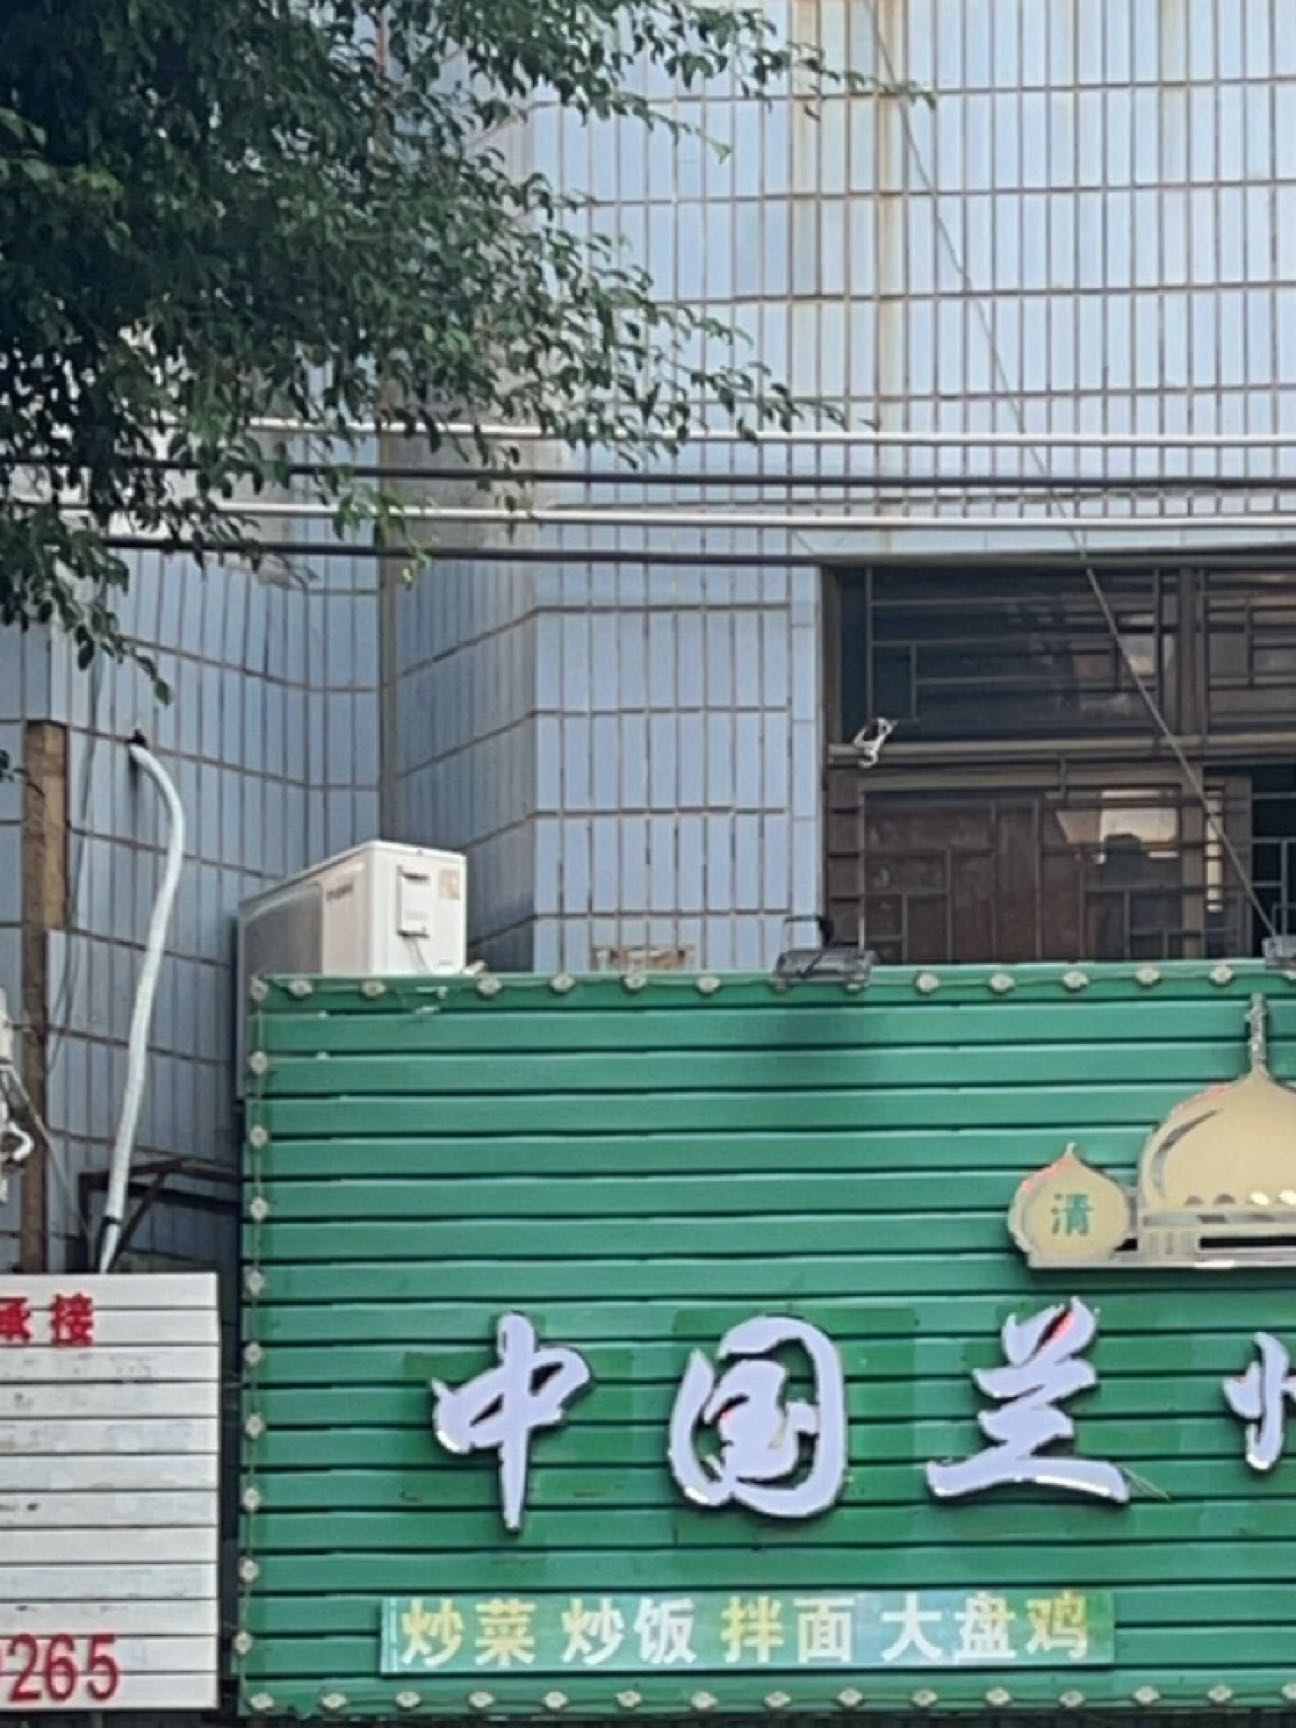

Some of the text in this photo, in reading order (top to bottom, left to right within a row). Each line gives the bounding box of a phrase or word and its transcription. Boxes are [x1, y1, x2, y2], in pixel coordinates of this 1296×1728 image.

[1050, 1192, 1091, 1235] 清
[401, 1590, 1088, 1667] 炒菜 炒饭 拌面 大盘鸡
